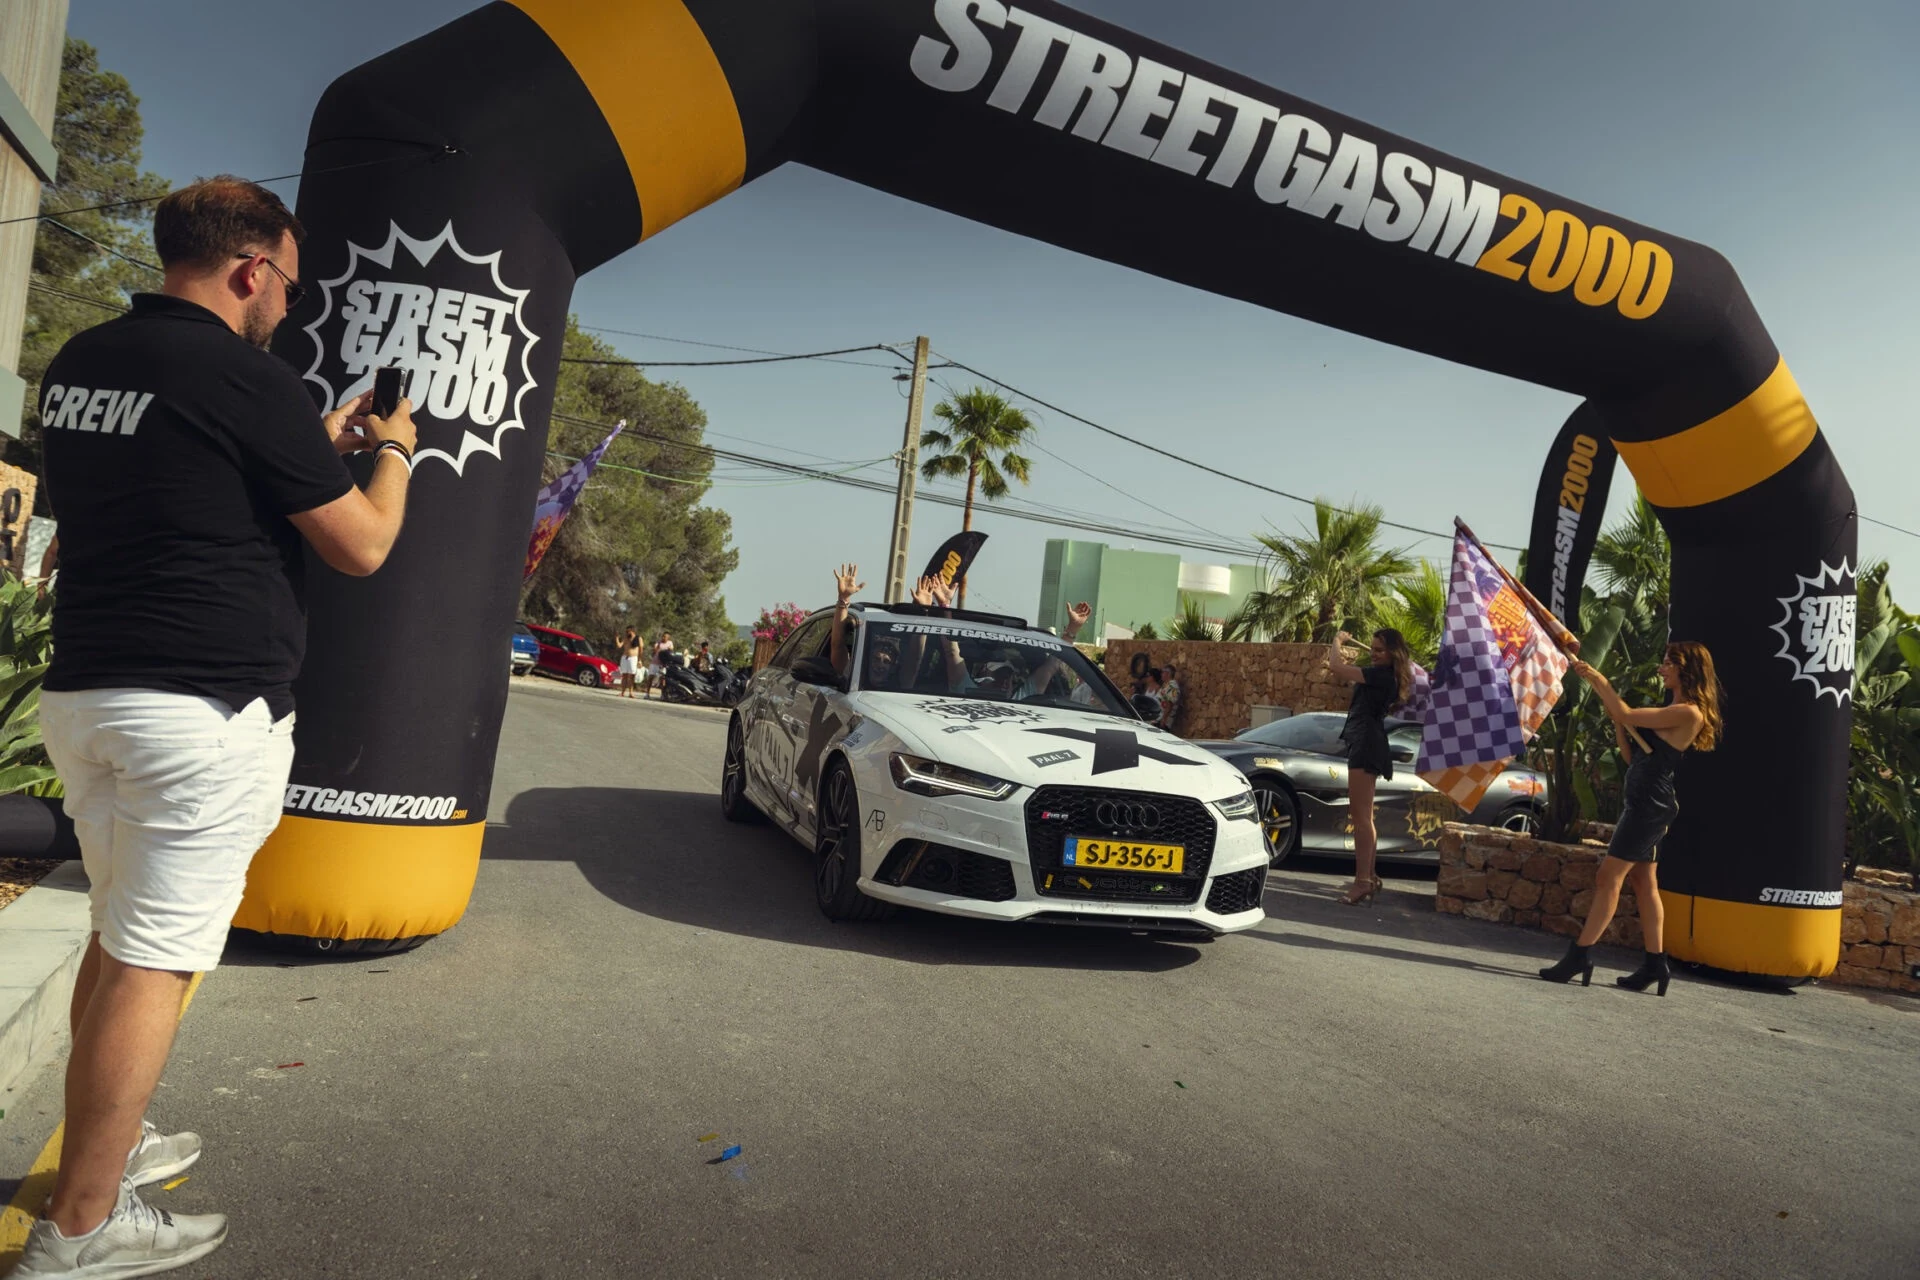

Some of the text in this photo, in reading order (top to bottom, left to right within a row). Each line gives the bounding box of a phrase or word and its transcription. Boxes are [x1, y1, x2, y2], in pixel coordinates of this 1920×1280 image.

[341, 279, 515, 337] STREET
[340, 309, 512, 380] GASM
[42, 384, 156, 436] CREW
[890, 623, 1063, 651] STREETGASM2000
[1800, 618, 1857, 652] GAS
[1036, 752, 1071, 765] PAAL 7
[1085, 843, 1175, 869] SJ-356-J
